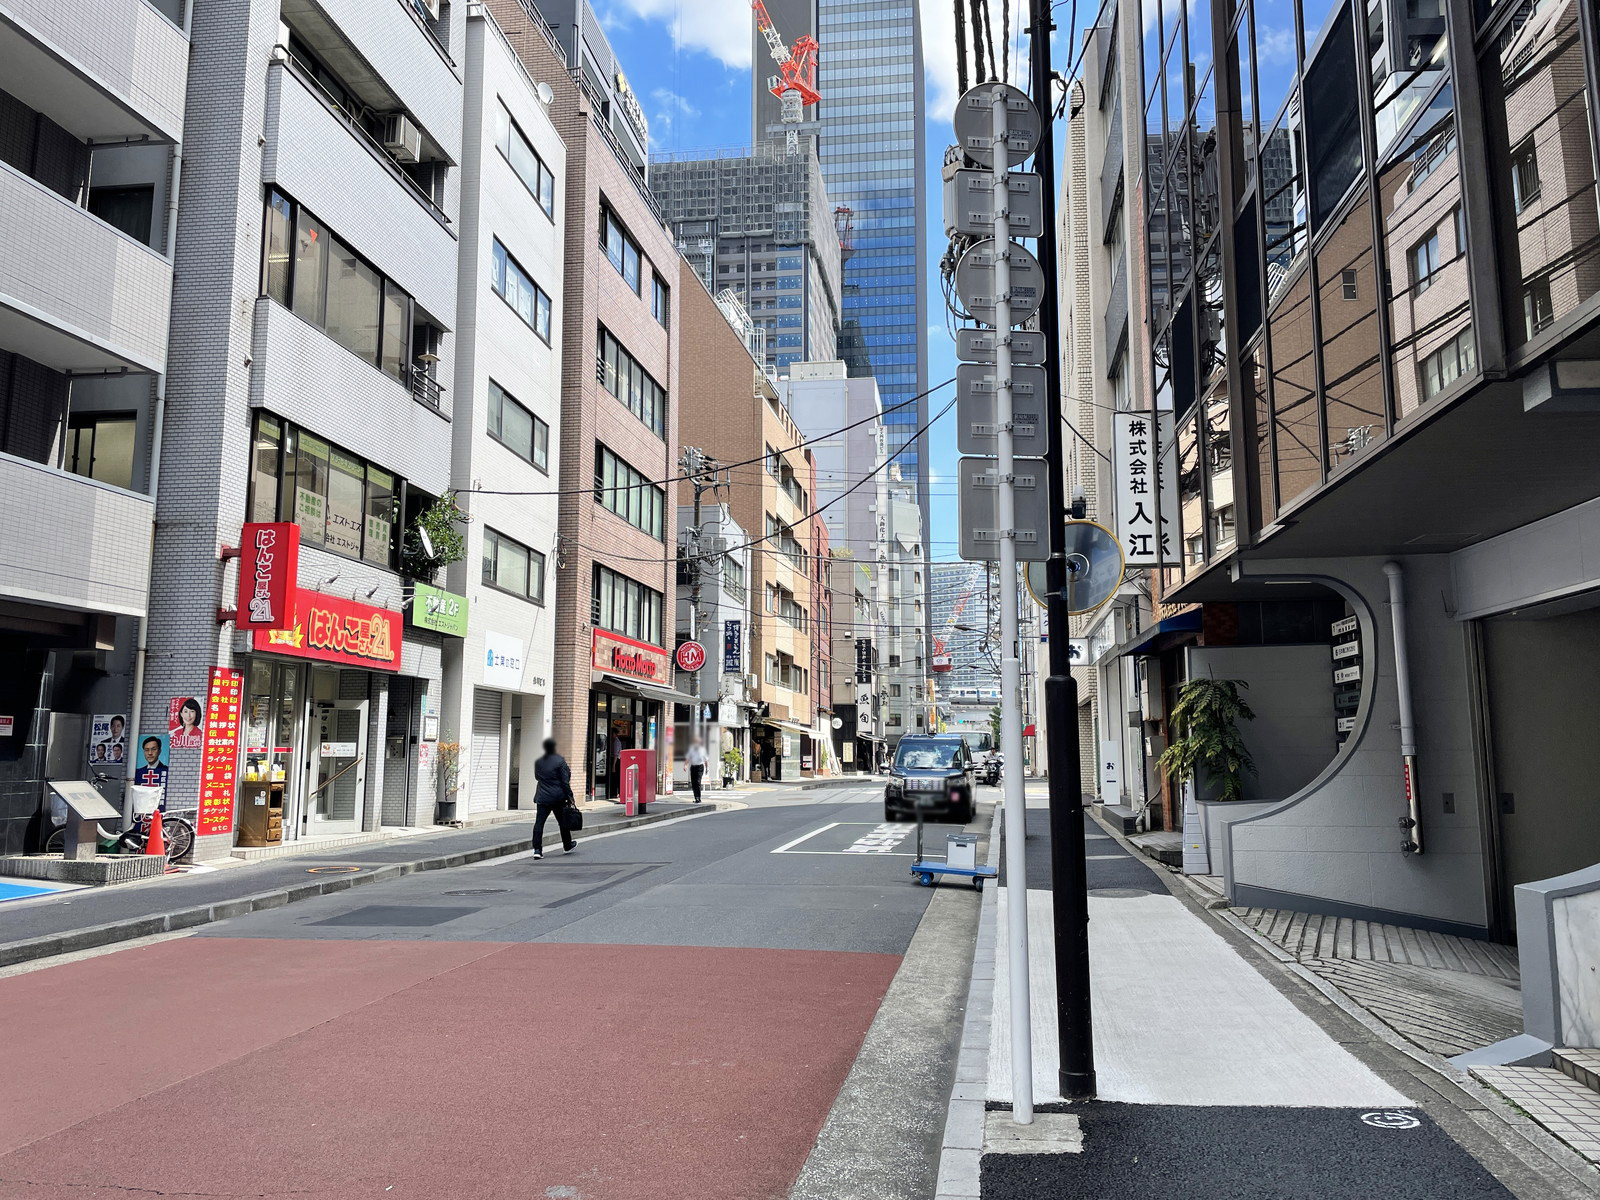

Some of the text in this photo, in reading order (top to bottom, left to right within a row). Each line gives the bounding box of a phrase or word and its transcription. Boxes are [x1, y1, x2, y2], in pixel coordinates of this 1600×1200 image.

[1128, 420, 1154, 556] 株式会社入江
[448, 598, 459, 617] 2F
[613, 646, 657, 677] Hotto Motto
[93, 722, 110, 732] 松尾
[207, 755, 233, 763] ライター
[1106, 762, 1115, 770] お
[203, 806, 230, 815] チケット
[202, 815, 229, 824] コースター
